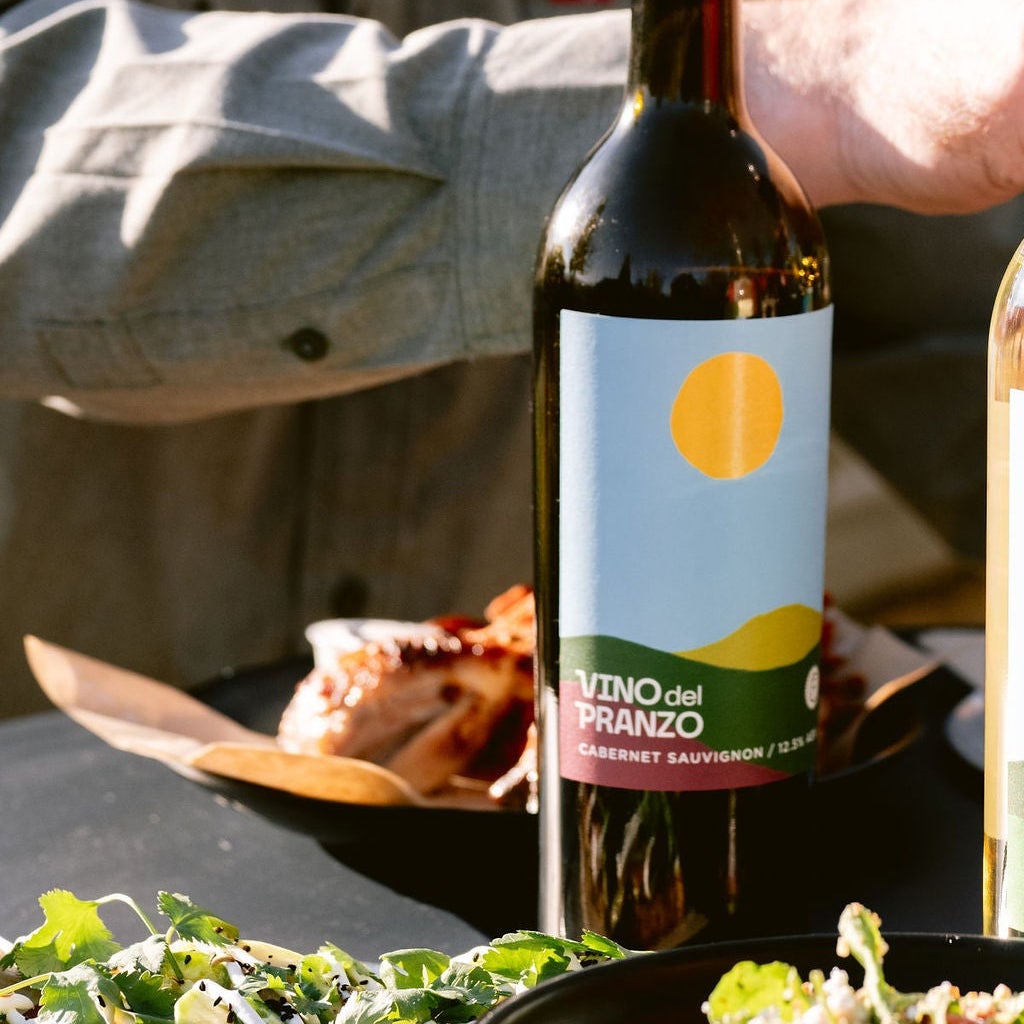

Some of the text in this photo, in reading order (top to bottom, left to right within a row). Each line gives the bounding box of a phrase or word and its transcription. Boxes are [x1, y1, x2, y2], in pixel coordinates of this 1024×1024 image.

[575, 669, 703, 707] VINO del
[575, 701, 704, 739] PRANZO
[578, 742, 662, 764] CABERNET
[667, 746, 764, 764] SAUVIGNON
